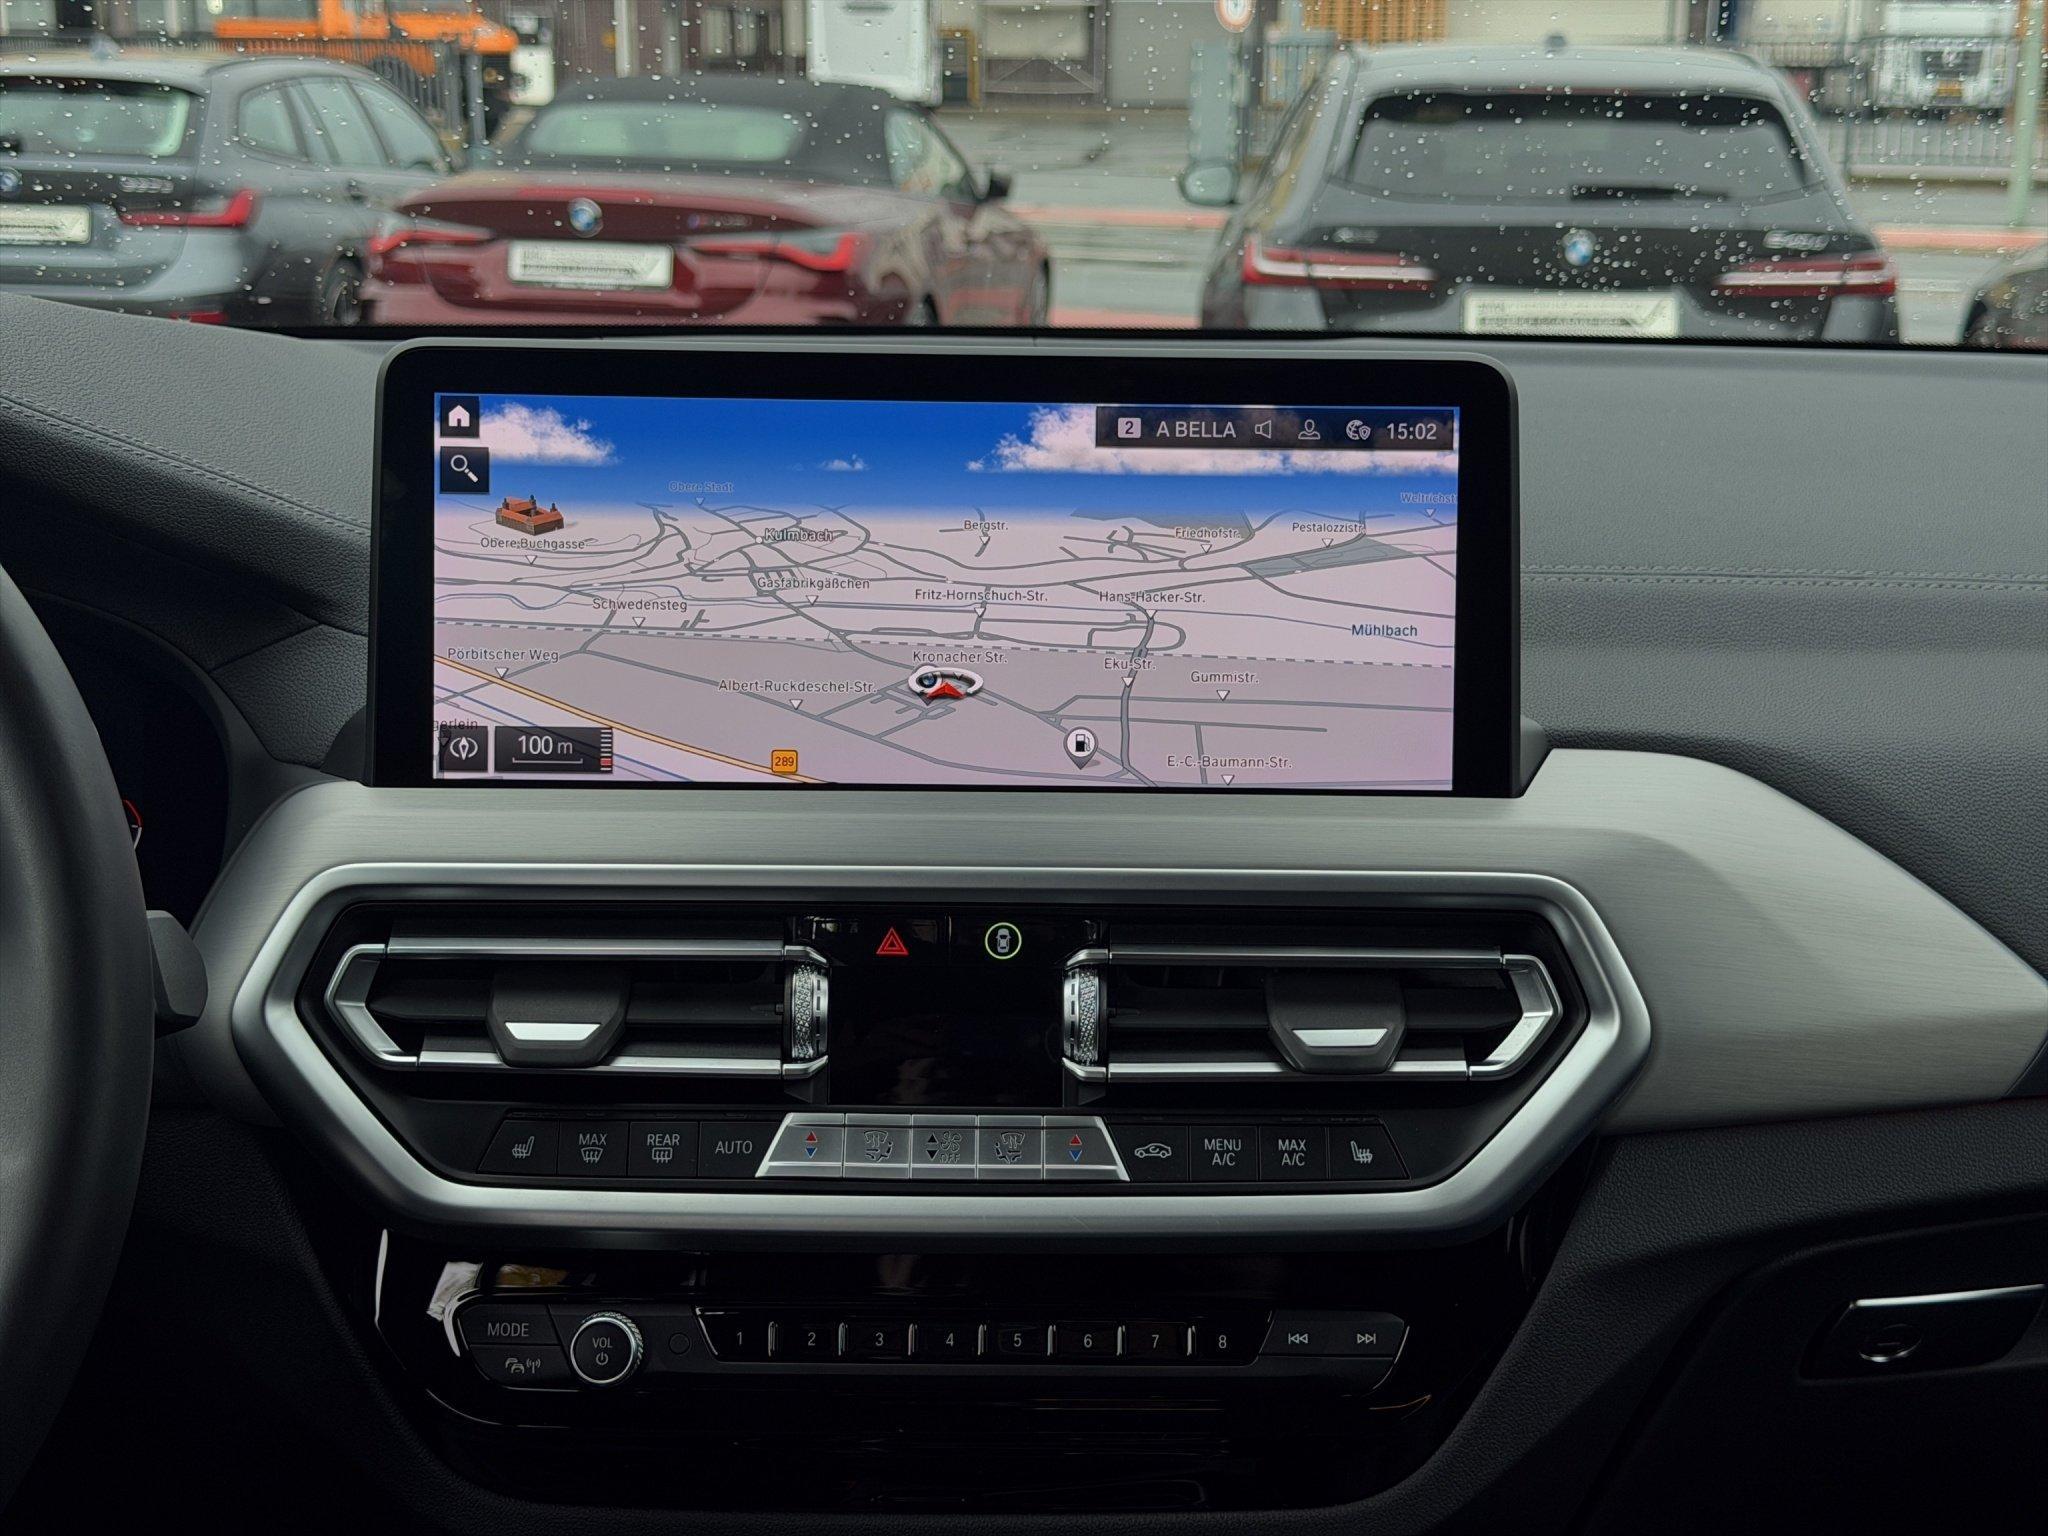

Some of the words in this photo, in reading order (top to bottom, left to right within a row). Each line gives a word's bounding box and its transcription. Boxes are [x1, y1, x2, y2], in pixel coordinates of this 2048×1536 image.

[1125, 421, 1134, 435] 2
[1156, 422, 1170, 438] A
[1175, 422, 1236, 438] BELLA
[1387, 423, 1437, 440] 15:02
[964, 519, 1008, 533] Bergstr.
[1175, 527, 1241, 540] Friedhofstr.
[1292, 521, 1366, 534] Pestalozzistr.
[764, 528, 834, 542] Kulmbach
[480, 536, 516, 549] Obere
[520, 536, 585, 551] Buchgasse
[757, 576, 870, 592] Gasfabrikgäßchen
[915, 588, 1048, 603] Fritz-Hornschuch-Str.
[1099, 591, 1206, 605] Hans-Hacker-Str.
[592, 598, 688, 613] Schwedensteg
[1352, 622, 1417, 638] Mühlbach
[448, 647, 525, 661] Pörbitscher
[529, 649, 559, 664] Weg
[913, 650, 981, 664] Kronacher
[985, 652, 1008, 665] Str.
[1104, 657, 1157, 671] Eku-Str.
[1191, 671, 1260, 685] Gummistr.
[718, 678, 877, 694] Albert-Ruckdeschel-Str.
[518, 736, 552, 755] 100
[557, 741, 573, 755] m
[774, 755, 795, 769] 289
[1167, 756, 1293, 770] E.-C.-Baumann-Str.
[579, 1133, 607, 1146] MAX
[647, 1133, 680, 1147] REAR
[1204, 1138, 1242, 1151] MENU
[1278, 1139, 1306, 1152] MAX
[715, 1140, 753, 1155] AUTO
[1212, 1152, 1236, 1166] A/C
[1281, 1152, 1305, 1166] A/C
[487, 1322, 530, 1338] MODE
[592, 1337, 613, 1349] VOL
[736, 1331, 743, 1346] 1
[807, 1332, 816, 1347] 2
[875, 1332, 884, 1347] 3
[945, 1332, 955, 1347] 4
[1013, 1333, 1022, 1348] 5
[1083, 1333, 1093, 1348] 6
[1151, 1334, 1160, 1349] 7
[1217, 1335, 1228, 1349] 8
